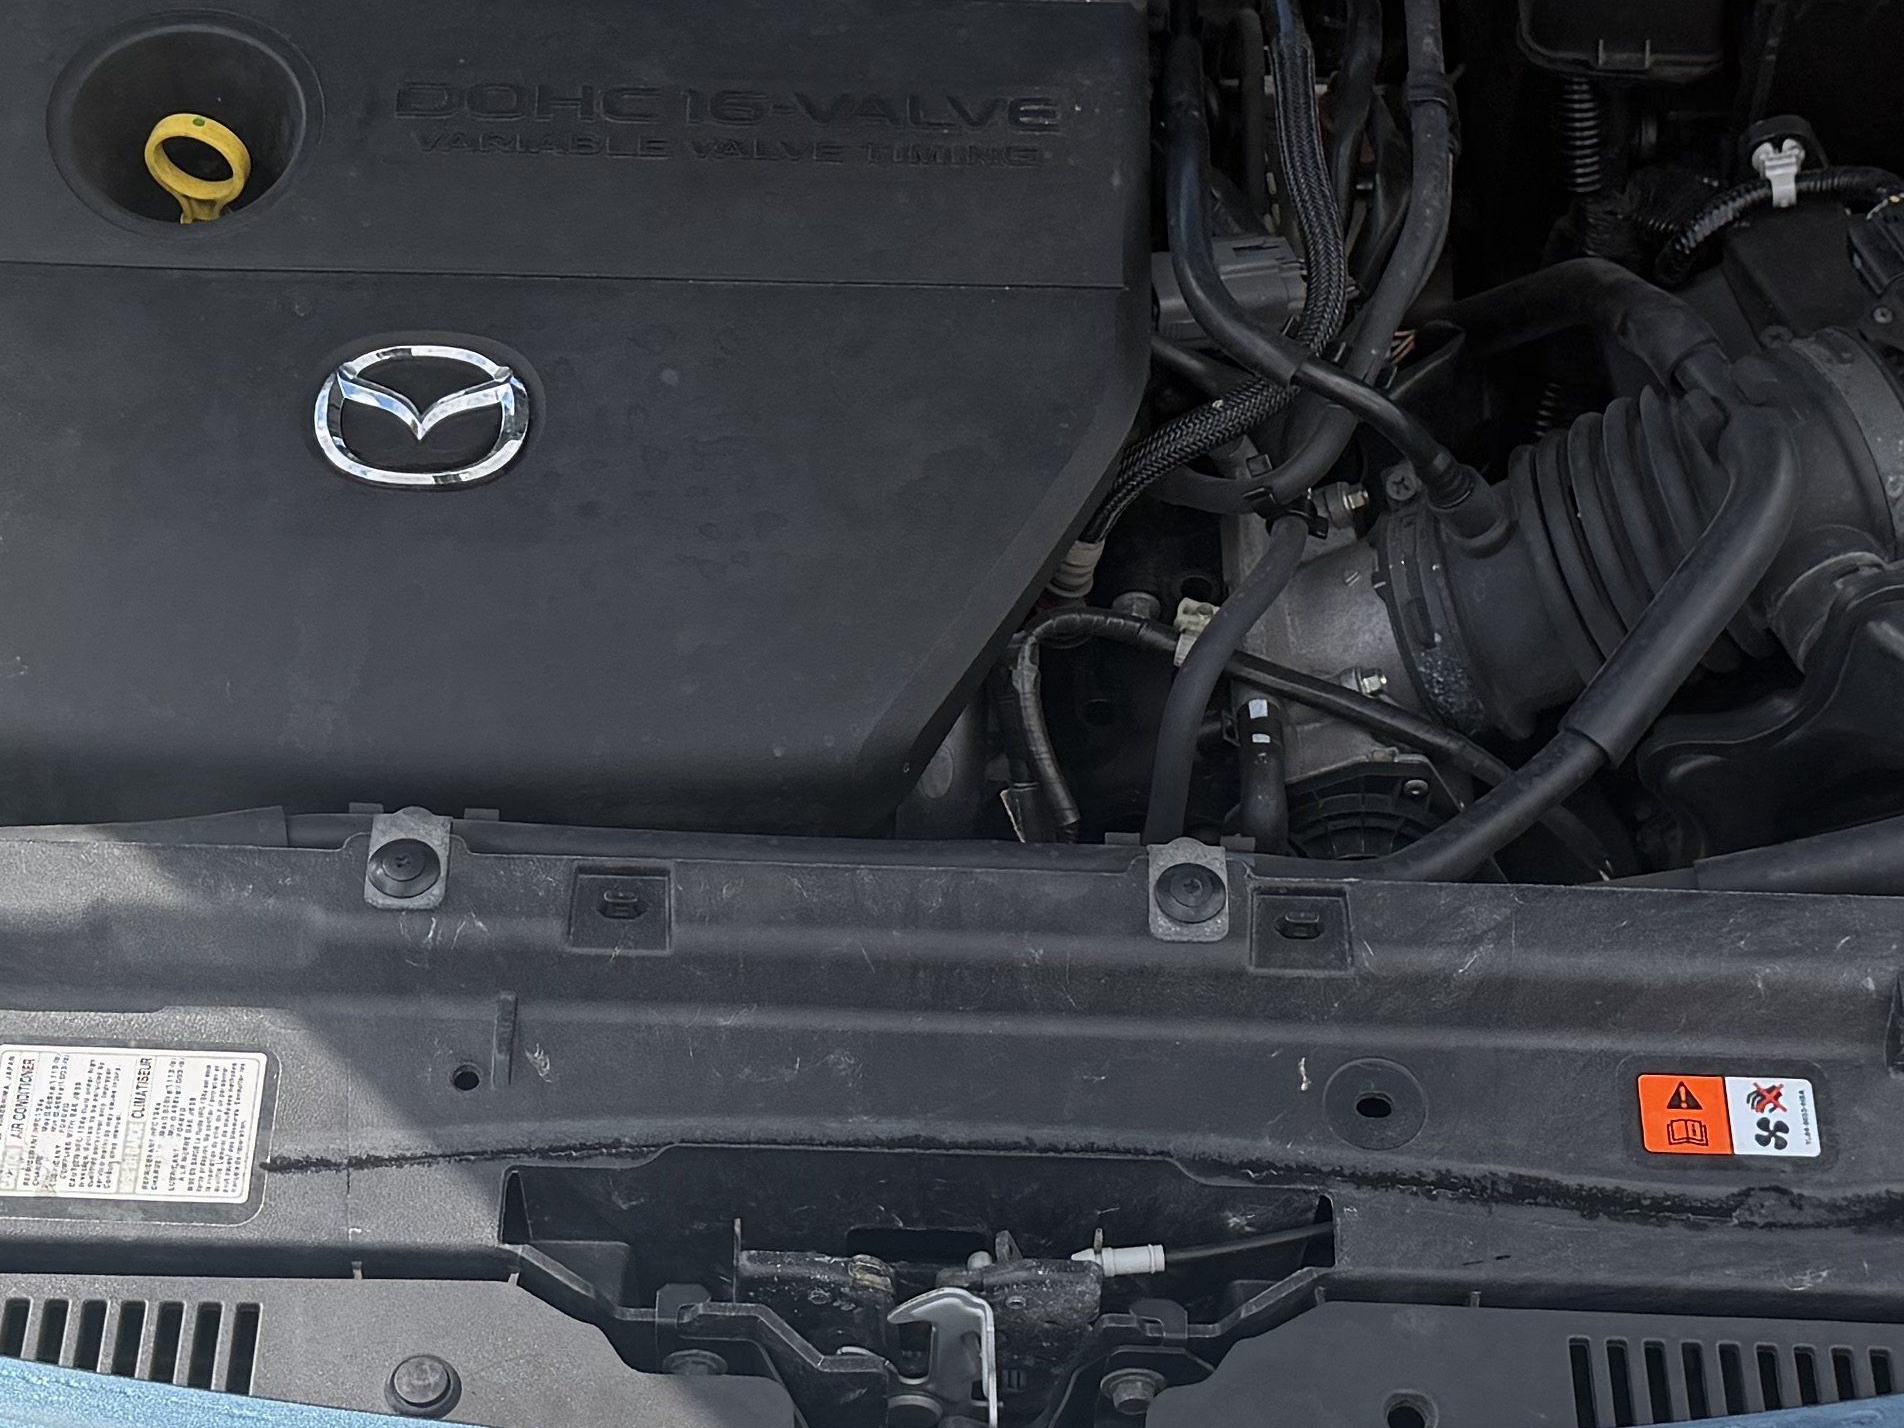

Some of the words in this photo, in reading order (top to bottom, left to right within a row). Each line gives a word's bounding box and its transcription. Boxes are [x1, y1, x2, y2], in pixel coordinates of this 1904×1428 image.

[394, 79, 662, 126] DOHC
[681, 87, 1061, 135] 16-VALVE
[412, 130, 669, 160] VARIABLE
[690, 134, 845, 164] VALVE
[864, 139, 1041, 169] TIMING
[13, 1058, 35, 1121] CONDITIONER
[131, 1057, 152, 1119] CLIMATISEUR
[10, 1122, 24, 1140] AIR
